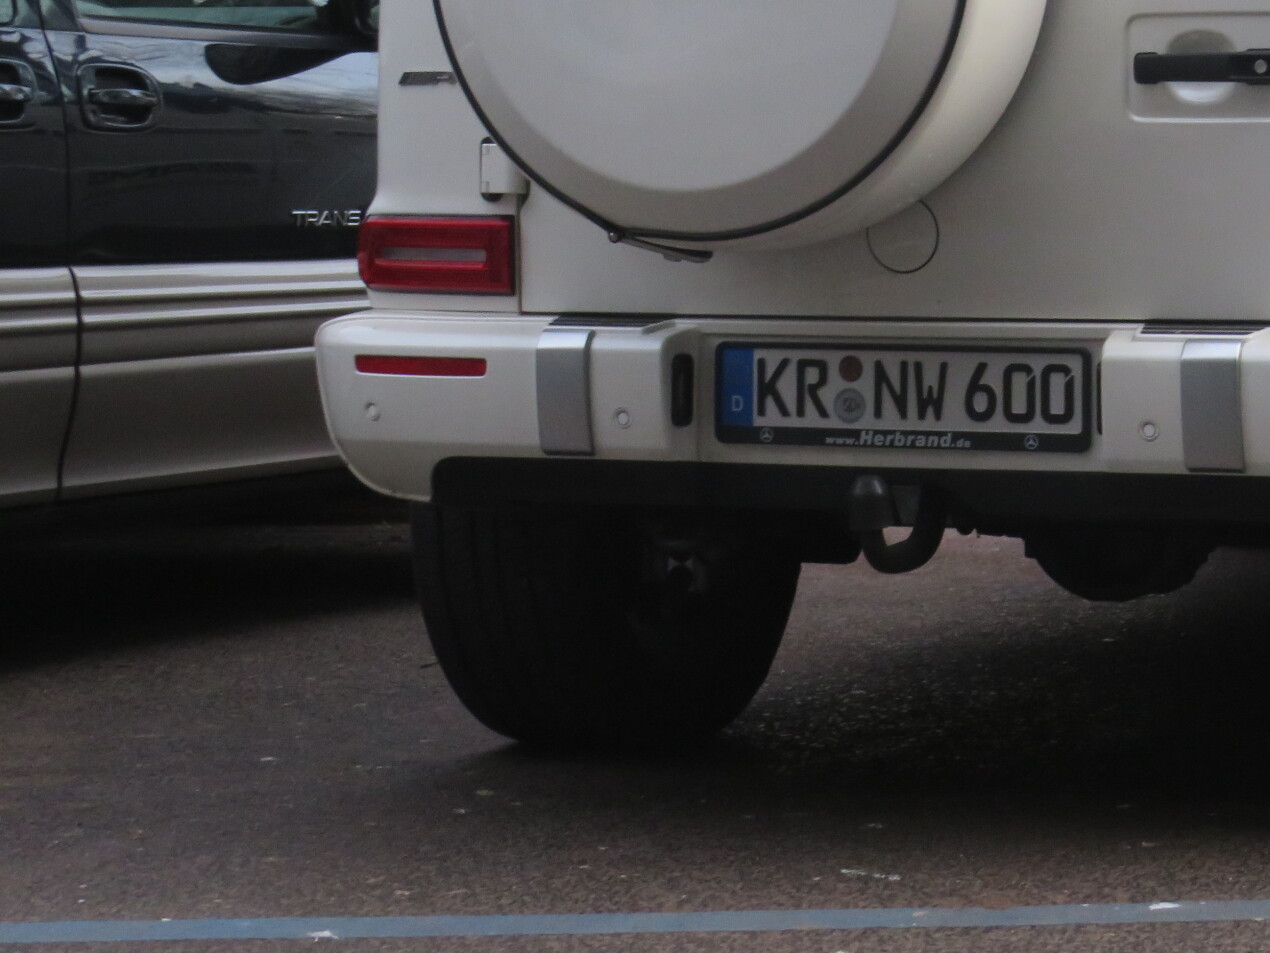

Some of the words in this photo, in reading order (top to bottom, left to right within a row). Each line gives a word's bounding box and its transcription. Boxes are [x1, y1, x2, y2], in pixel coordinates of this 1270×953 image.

[965, 362, 1075, 424] 600
[731, 395, 744, 412] D
[824, 430, 972, 449] www.Herbrand.de
